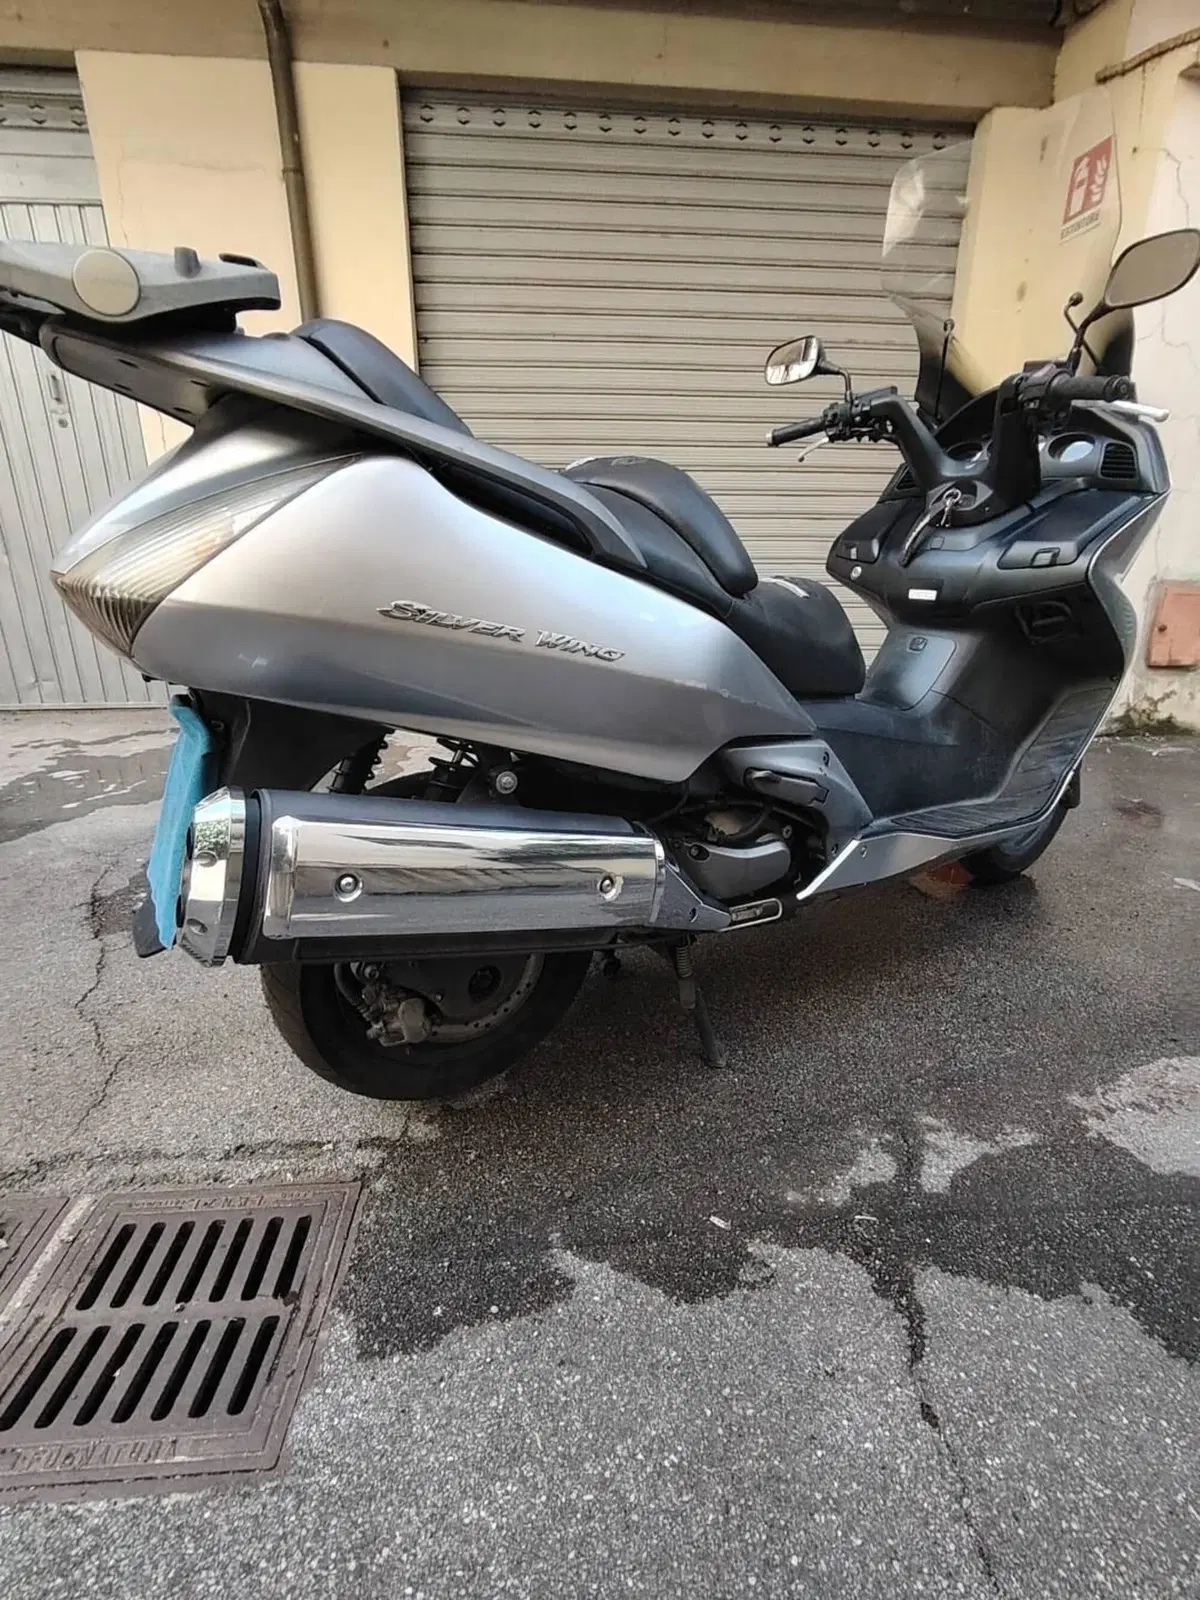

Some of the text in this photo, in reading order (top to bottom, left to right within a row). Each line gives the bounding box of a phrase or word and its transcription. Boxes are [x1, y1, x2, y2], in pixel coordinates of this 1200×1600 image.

[1060, 211, 1101, 241] ESTINTORE
[376, 600, 626, 662] SILVER WING
